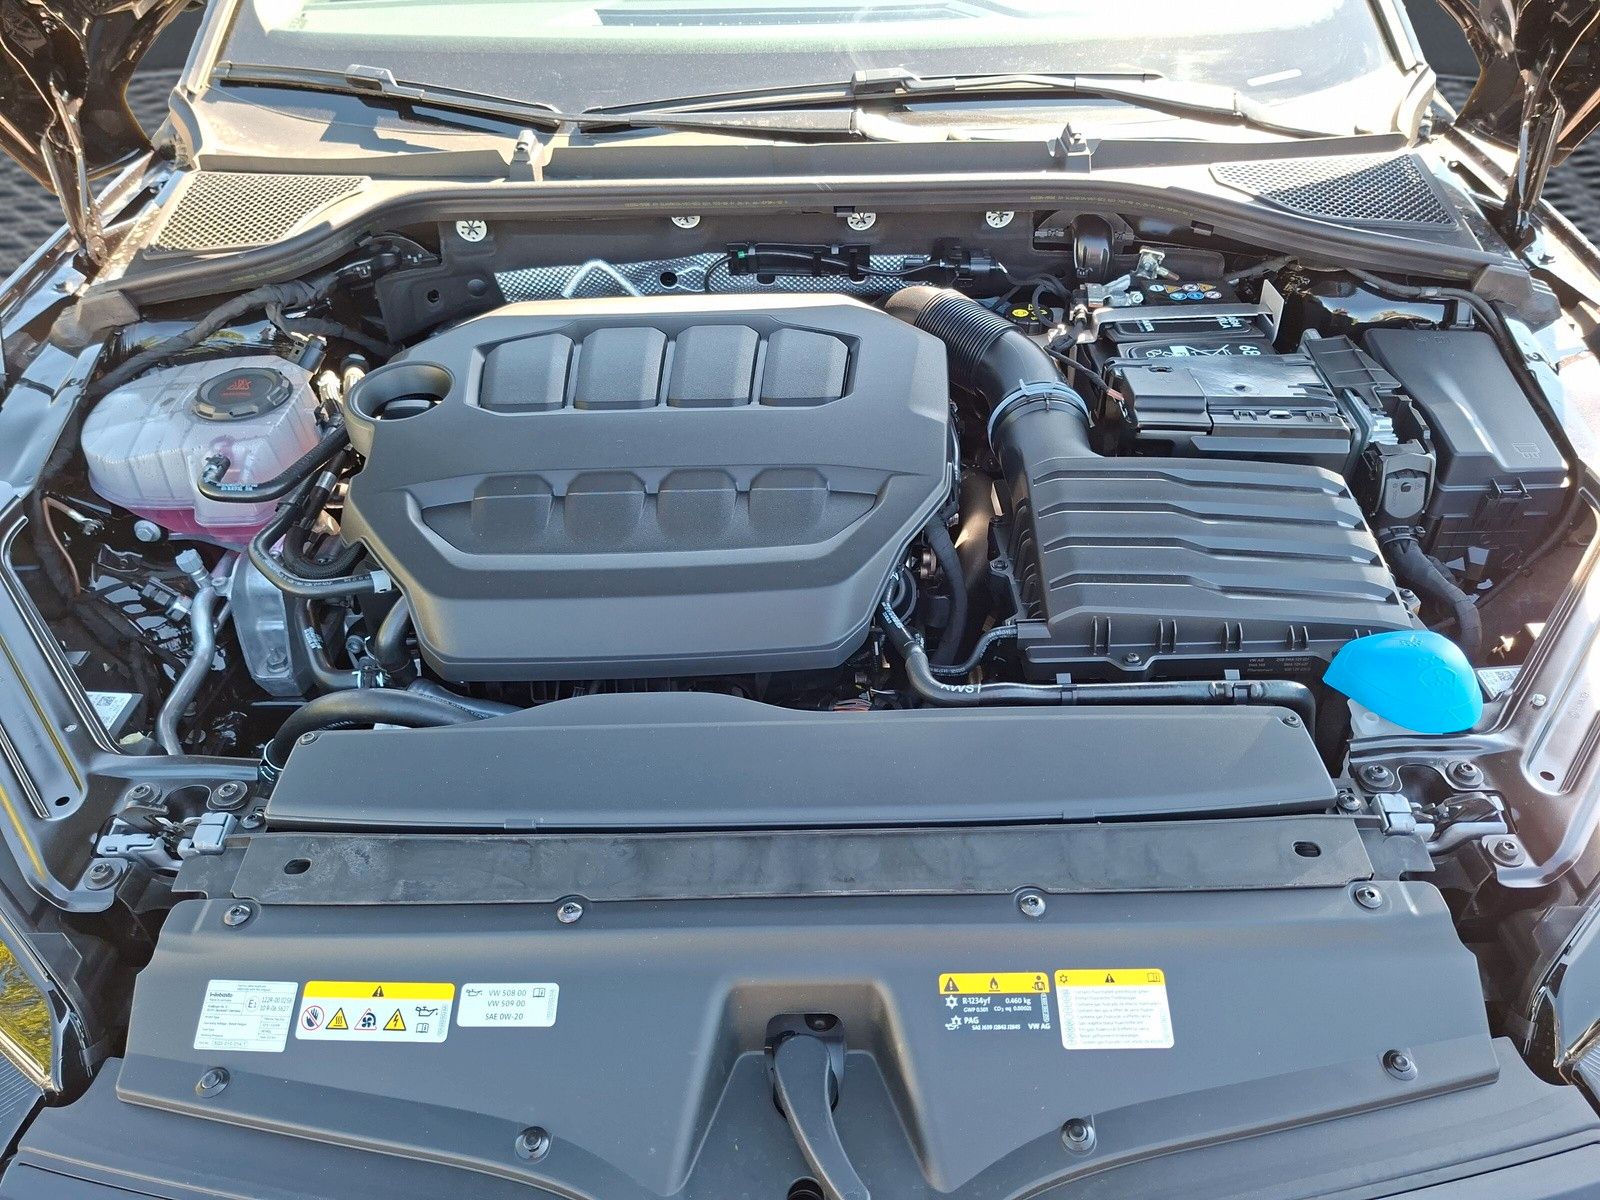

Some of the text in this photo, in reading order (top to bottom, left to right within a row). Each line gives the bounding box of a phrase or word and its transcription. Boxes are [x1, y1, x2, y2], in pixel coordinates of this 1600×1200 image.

[962, 996, 991, 1006] R-1234yf
[1023, 997, 1032, 1006] kg
[963, 1016, 979, 1024] PAG
